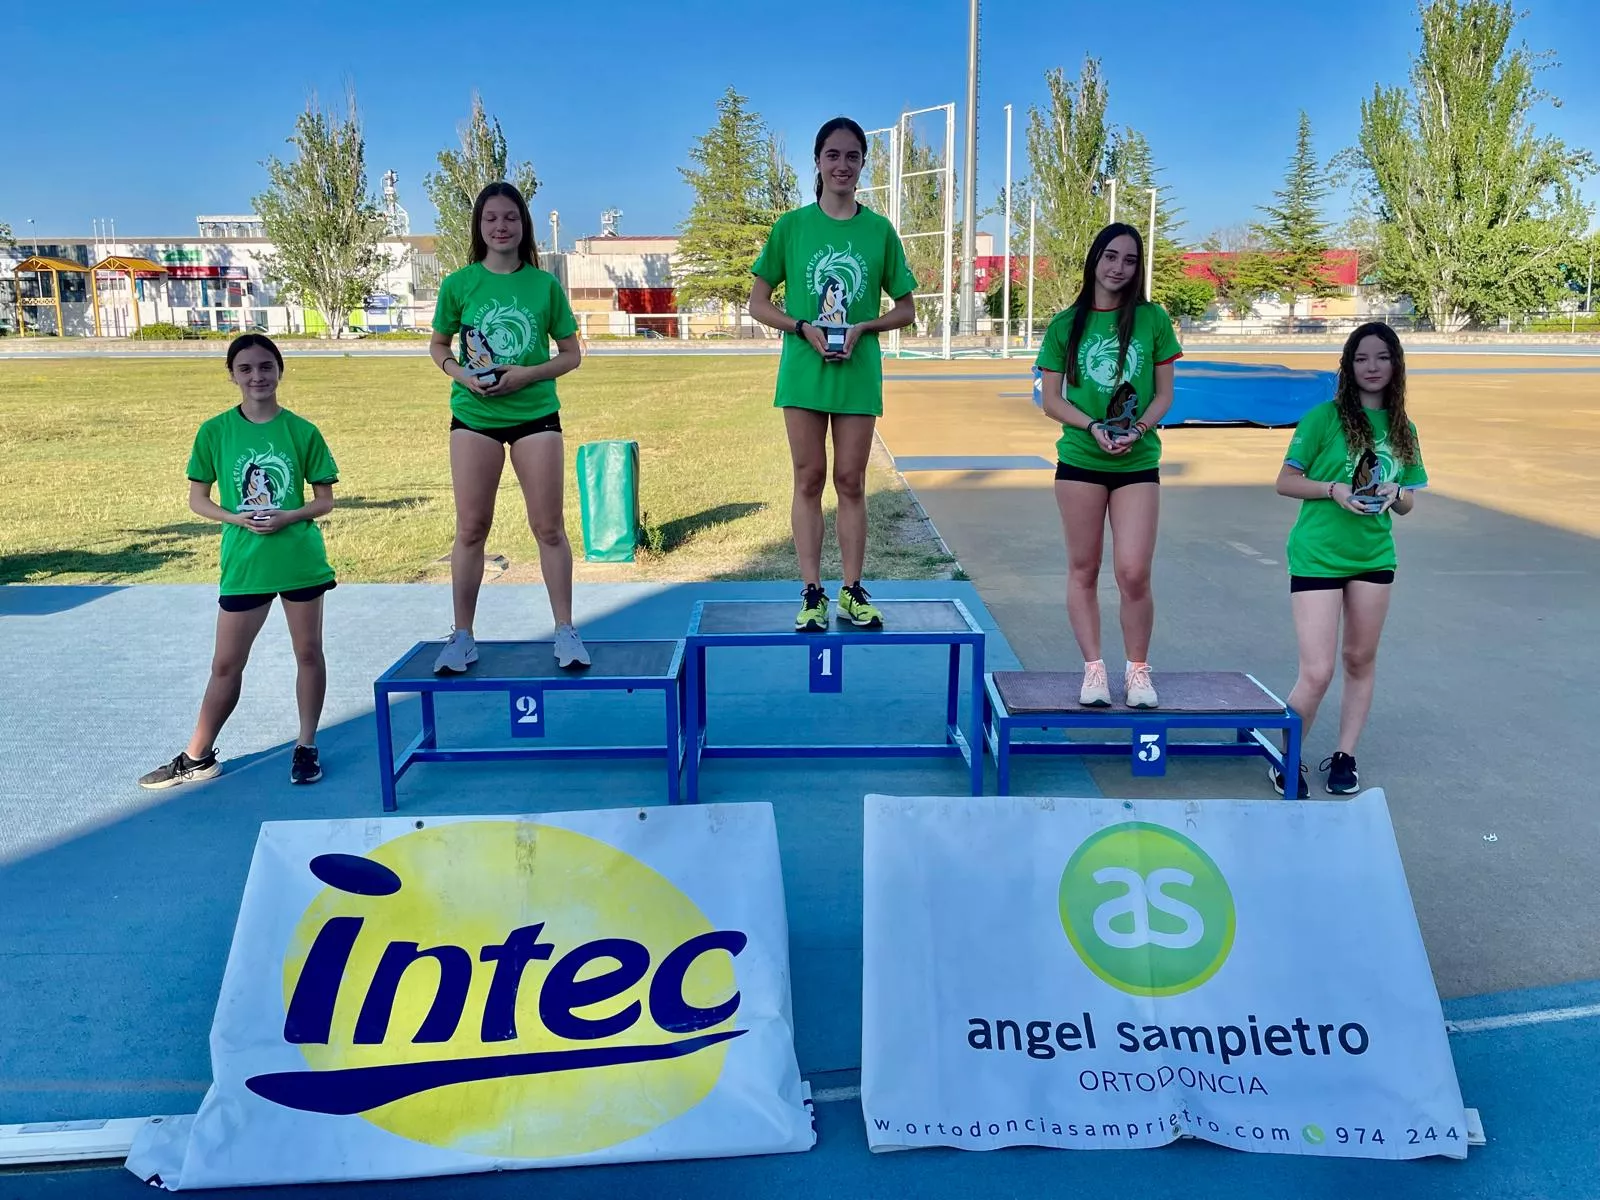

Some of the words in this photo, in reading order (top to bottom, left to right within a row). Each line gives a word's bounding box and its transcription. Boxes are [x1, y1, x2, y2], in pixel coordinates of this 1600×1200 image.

[817, 648, 833, 676] 1
[515, 695, 538, 724] 2
[1138, 734, 1161, 762] 3
[1092, 866, 1204, 949] as
[967, 1013, 1098, 1060] angel
[1117, 1014, 1370, 1065] sampietro
[1079, 1066, 1269, 1096] ORTODONCIA
[1336, 1127, 1386, 1145] 974
[1407, 1126, 1460, 1145] 244
